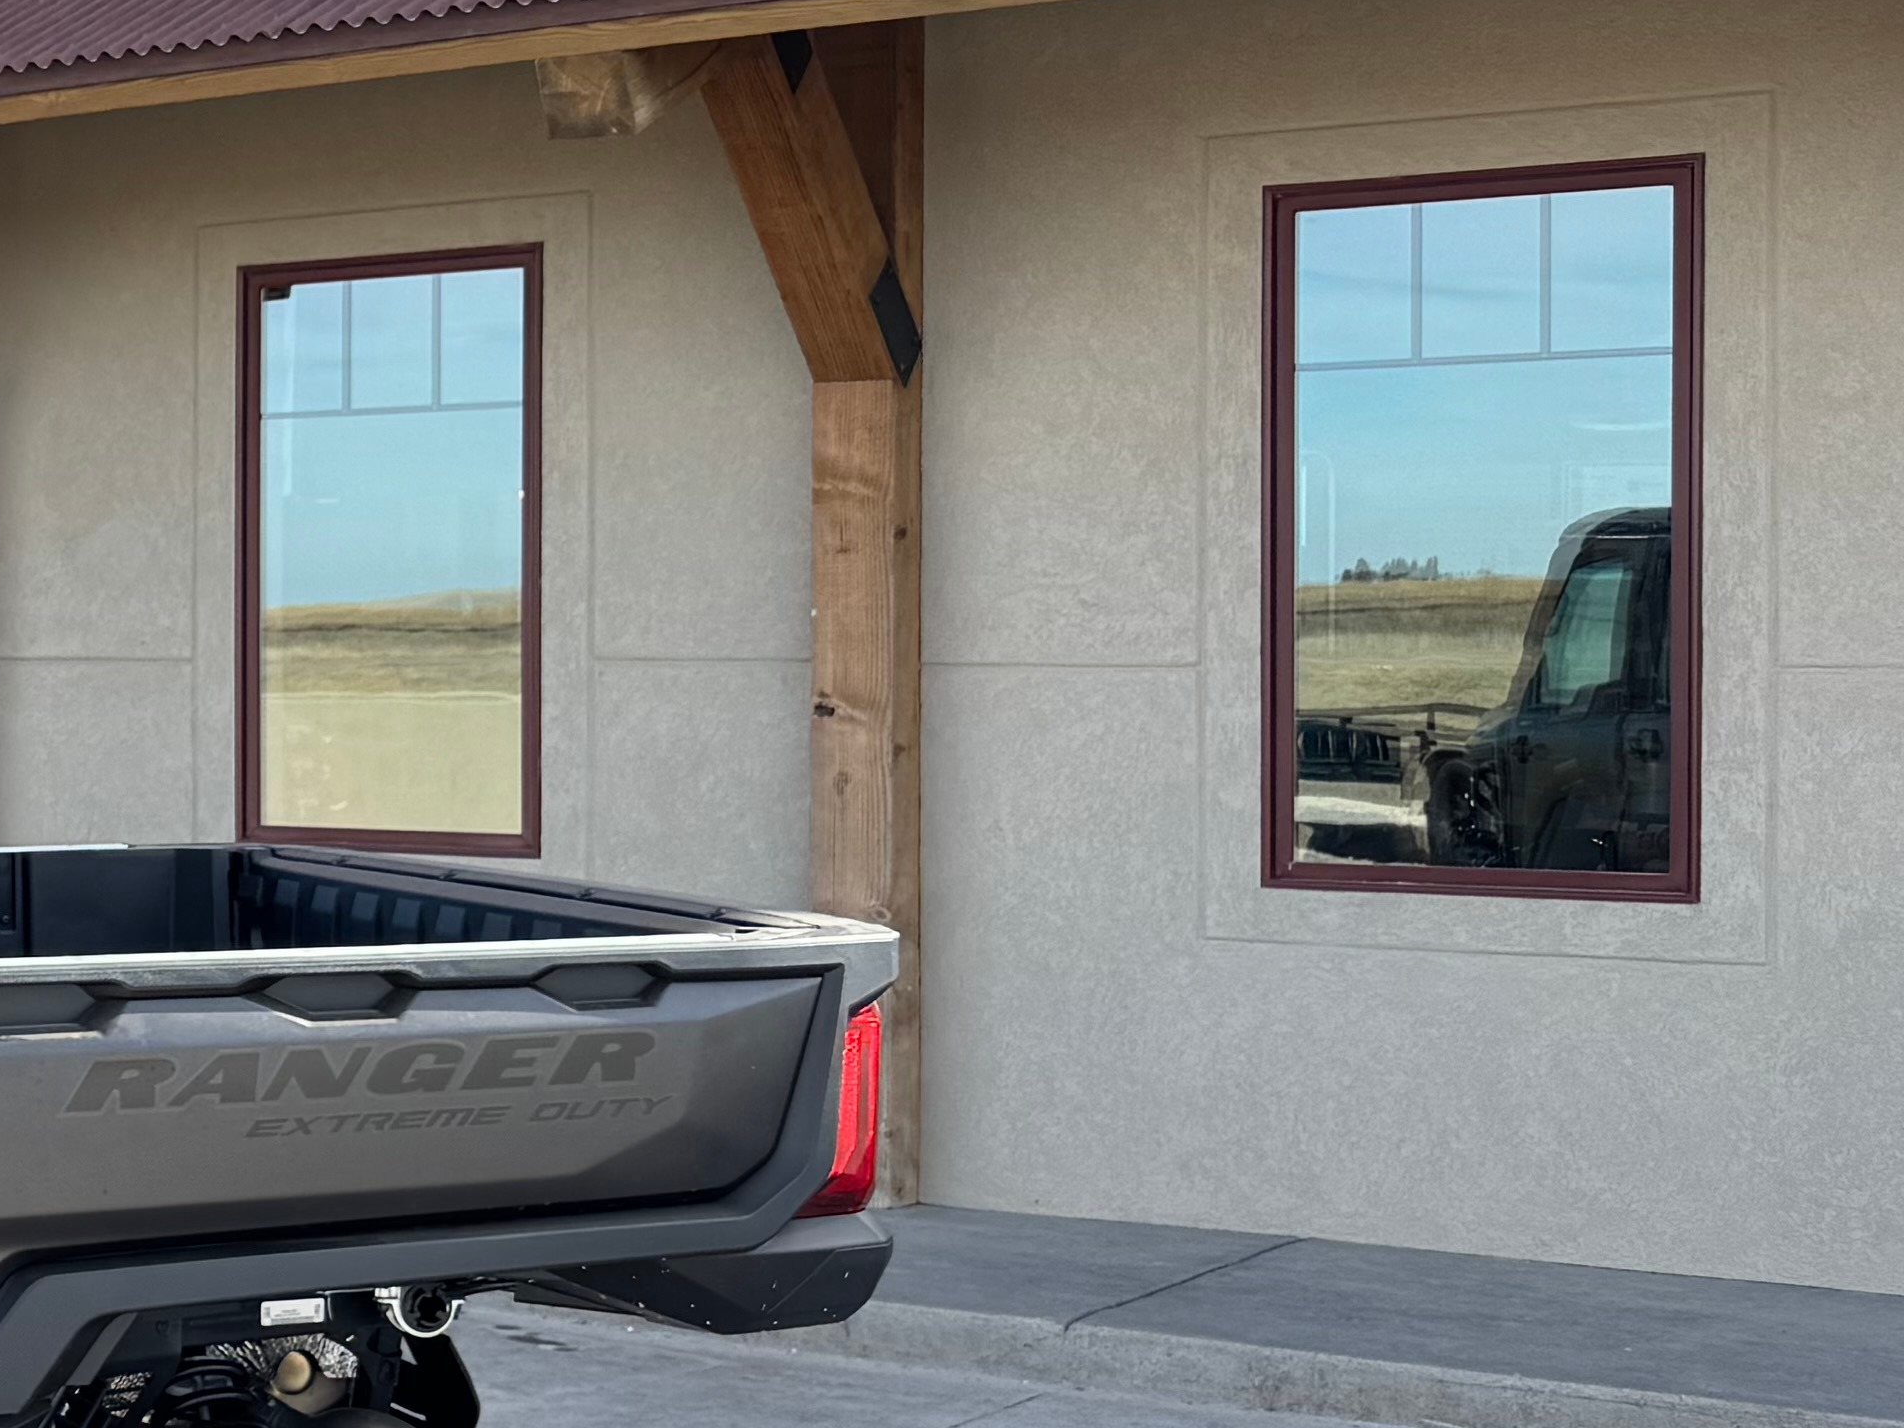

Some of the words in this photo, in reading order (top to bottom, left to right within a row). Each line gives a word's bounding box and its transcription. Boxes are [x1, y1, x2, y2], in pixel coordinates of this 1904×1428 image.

[60, 1030, 657, 1115] RANGER
[244, 1103, 512, 1139] EXTREME
[528, 1094, 673, 1125] DUTY
